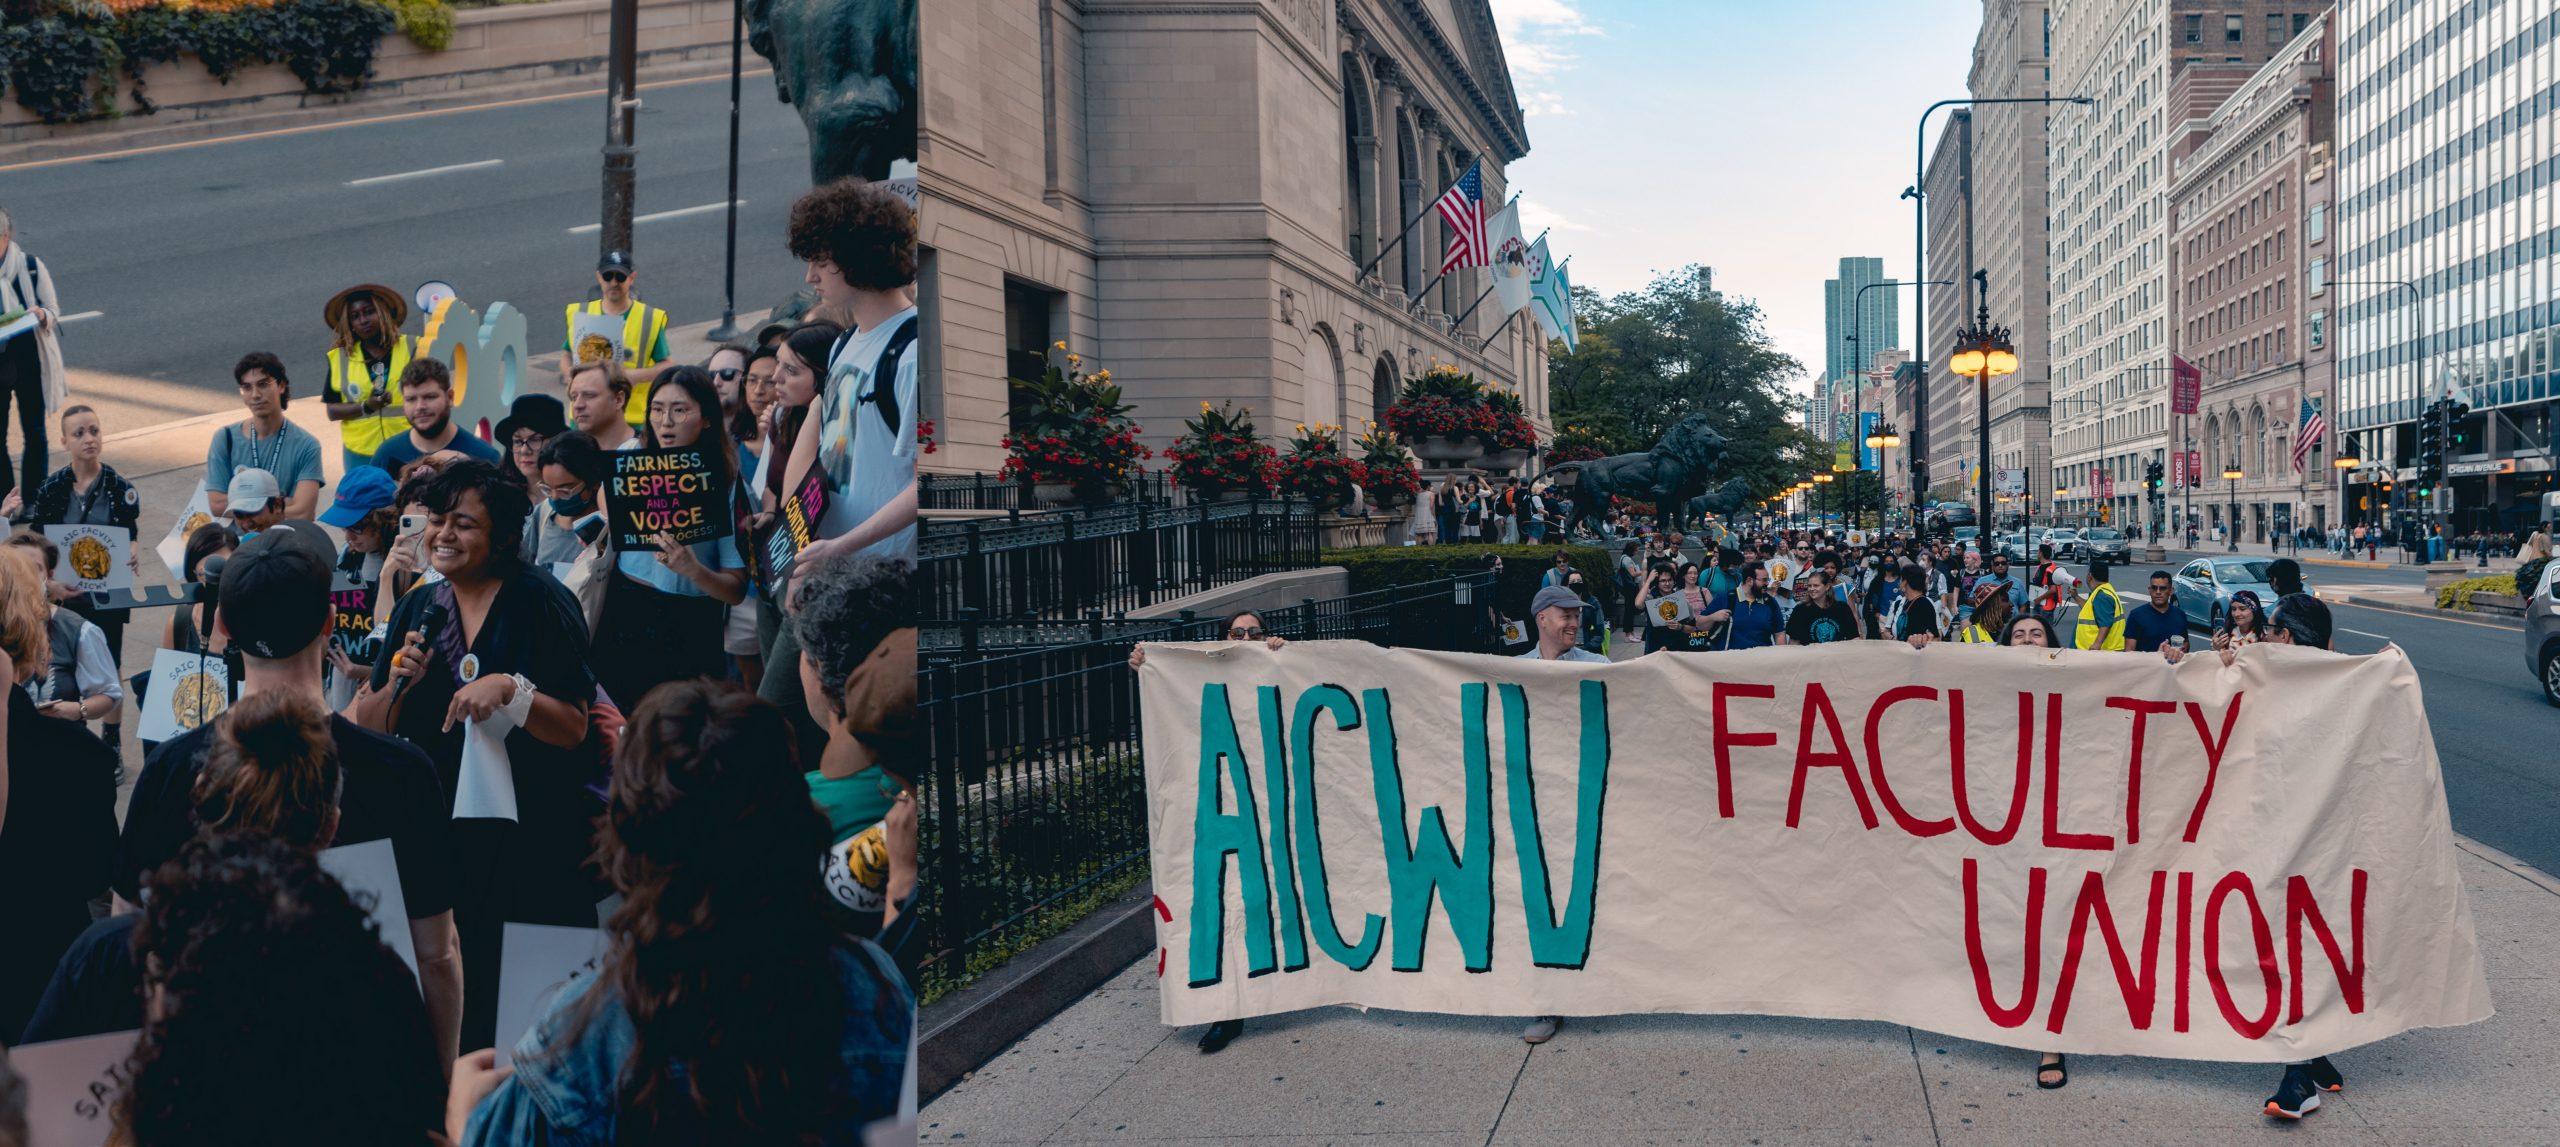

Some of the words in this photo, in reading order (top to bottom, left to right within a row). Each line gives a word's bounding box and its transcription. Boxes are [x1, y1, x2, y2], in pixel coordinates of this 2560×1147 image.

[2474, 462, 2502, 473] AVENUE
[646, 499, 668, 509] AND
[672, 498, 680, 509] A
[802, 477, 823, 525] FAIR
[629, 506, 704, 531] VOICE
[785, 495, 812, 554] CONTRAC
[60, 529, 79, 547] SAIC
[624, 534, 637, 545] IN
[329, 590, 367, 609] AIR
[328, 632, 371, 658] OW!
[1689, 638, 1705, 646] OW!
[169, 660, 195, 681] SAIC
[1712, 681, 2244, 851] FACULTY
[1962, 857, 2367, 1041] UNION
